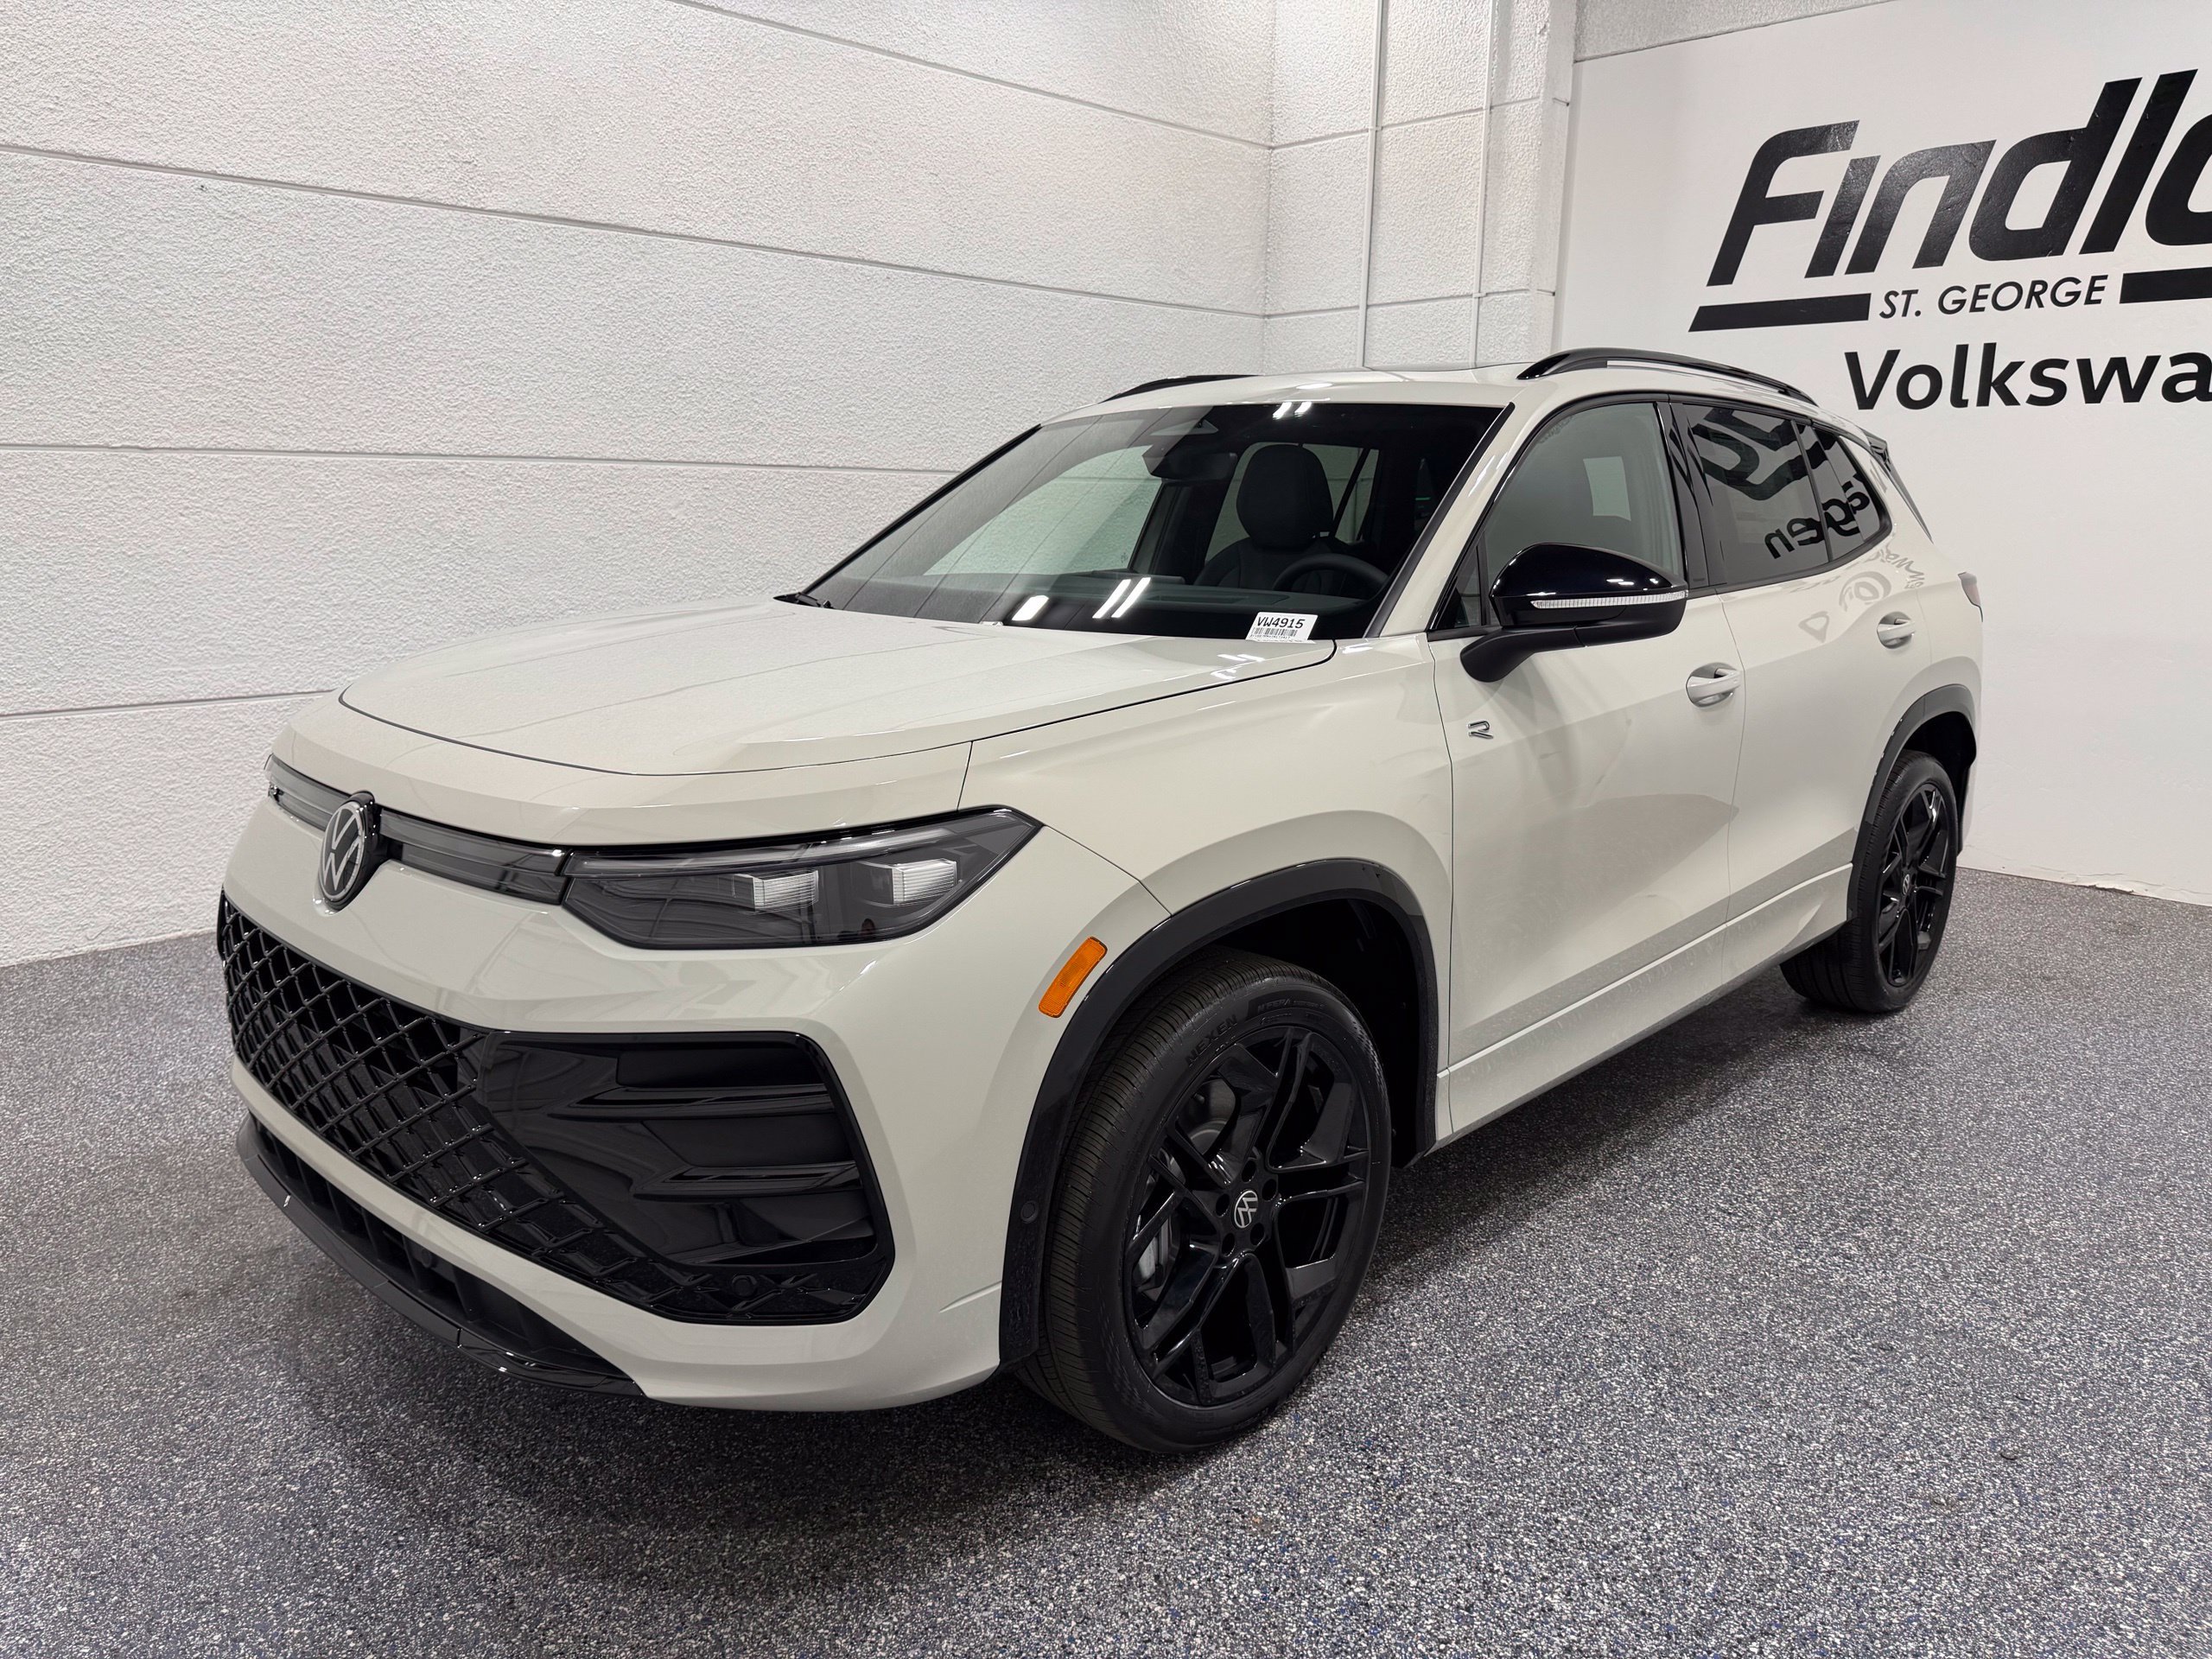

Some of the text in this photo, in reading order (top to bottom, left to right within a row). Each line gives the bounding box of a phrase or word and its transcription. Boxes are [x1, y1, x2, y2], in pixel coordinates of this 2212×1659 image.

[1878, 274, 2108, 319] ST. GEORGE
[1844, 342, 2212, 411] Volkswa
[1256, 616, 1306, 629] VW4915
